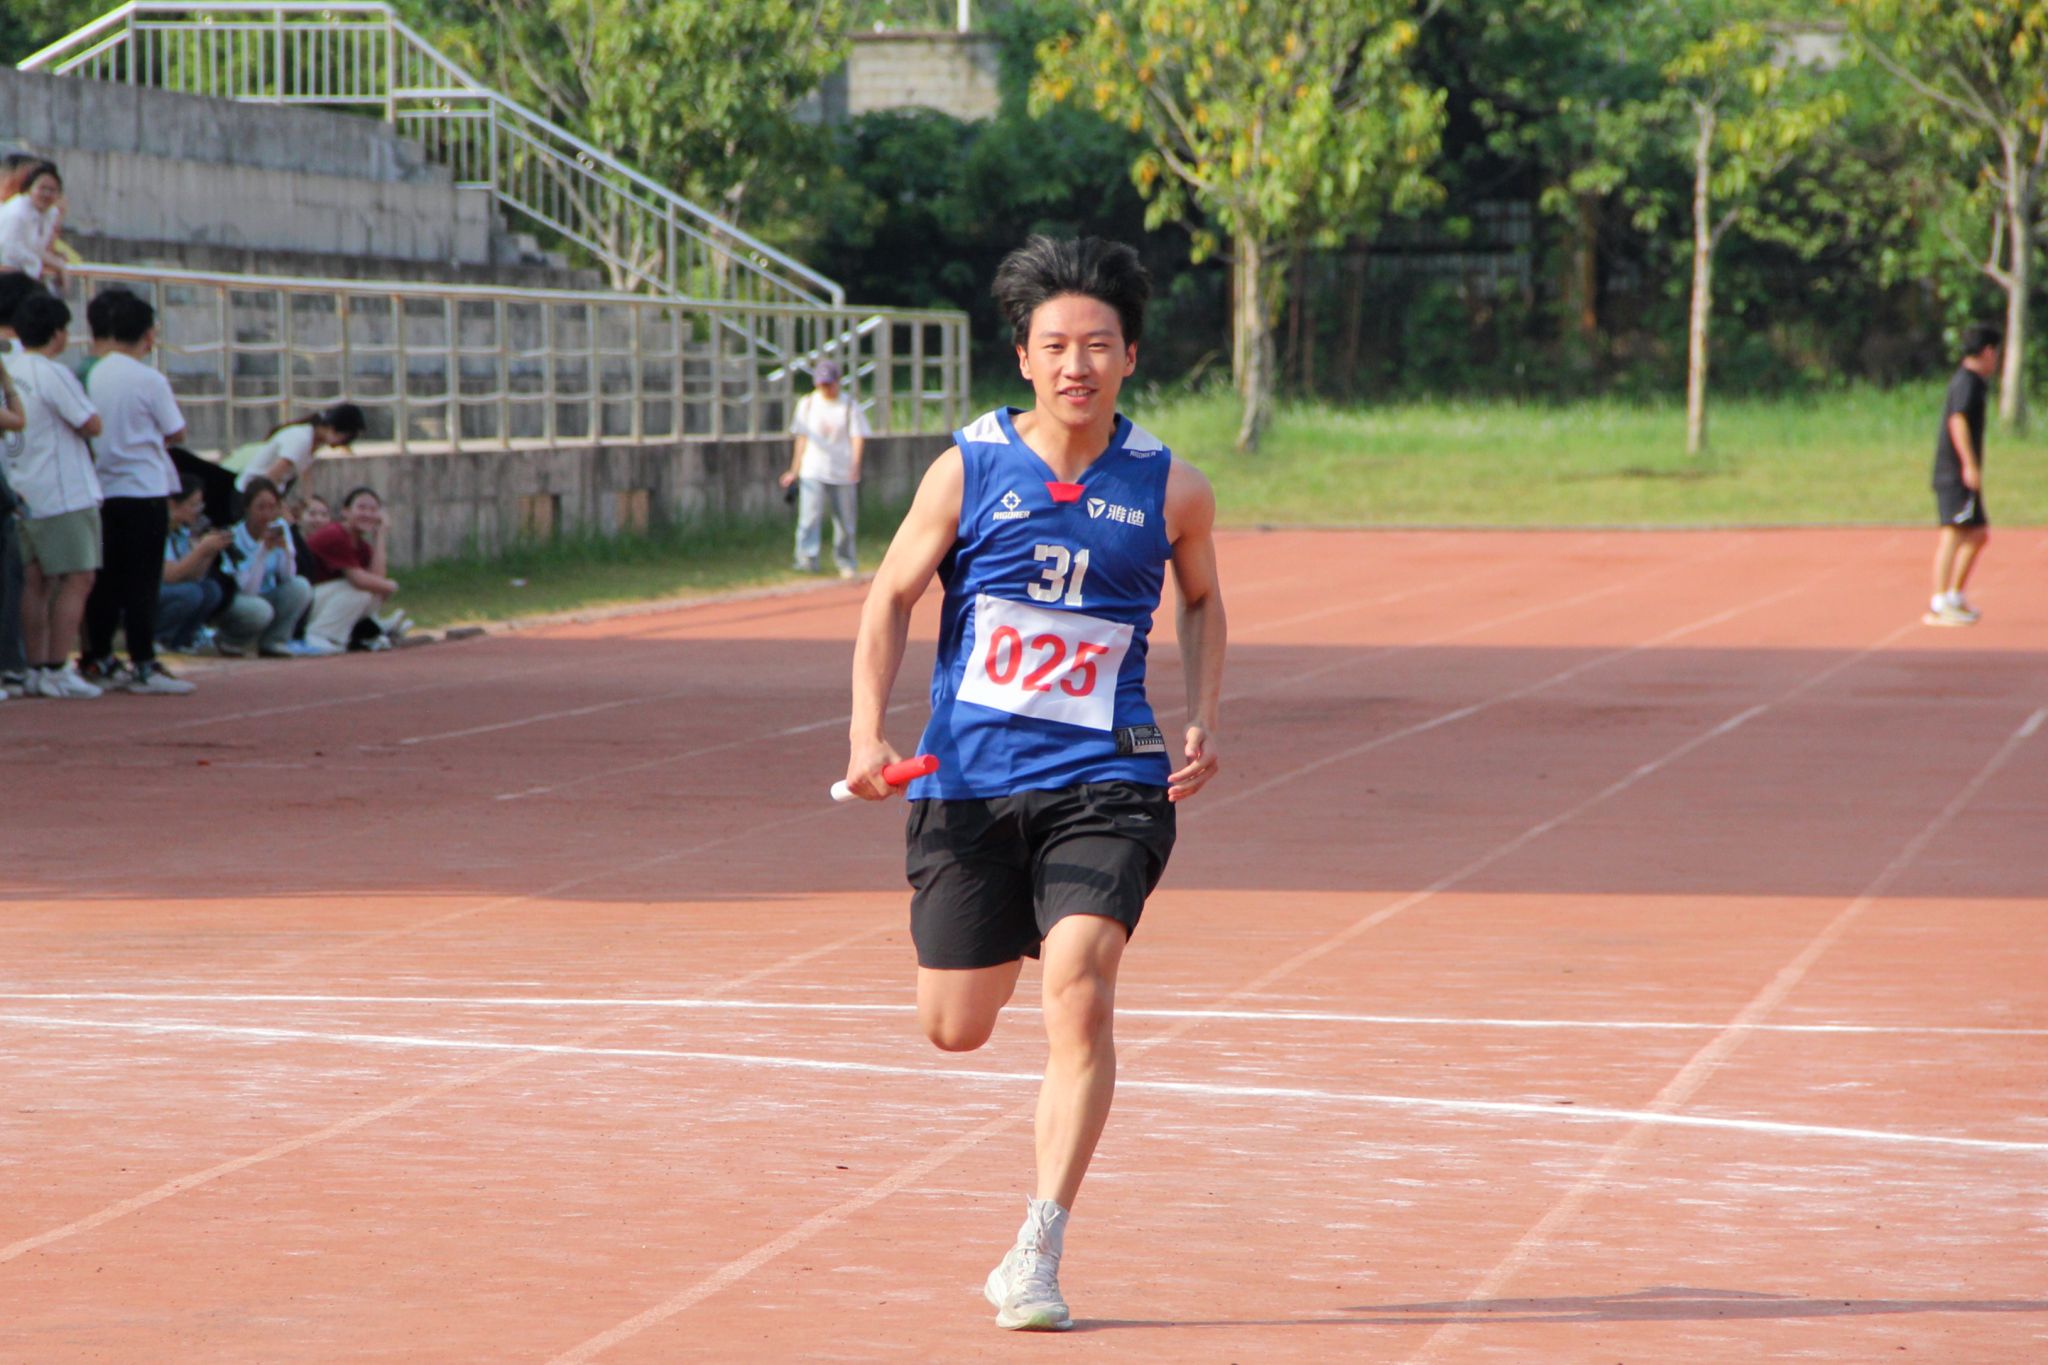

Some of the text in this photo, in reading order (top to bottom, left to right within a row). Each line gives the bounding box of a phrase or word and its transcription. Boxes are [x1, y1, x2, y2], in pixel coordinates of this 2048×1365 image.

[1106, 504, 1145, 527] 雅迪
[1027, 544, 1089, 607] 31
[985, 625, 1110, 697] 025
